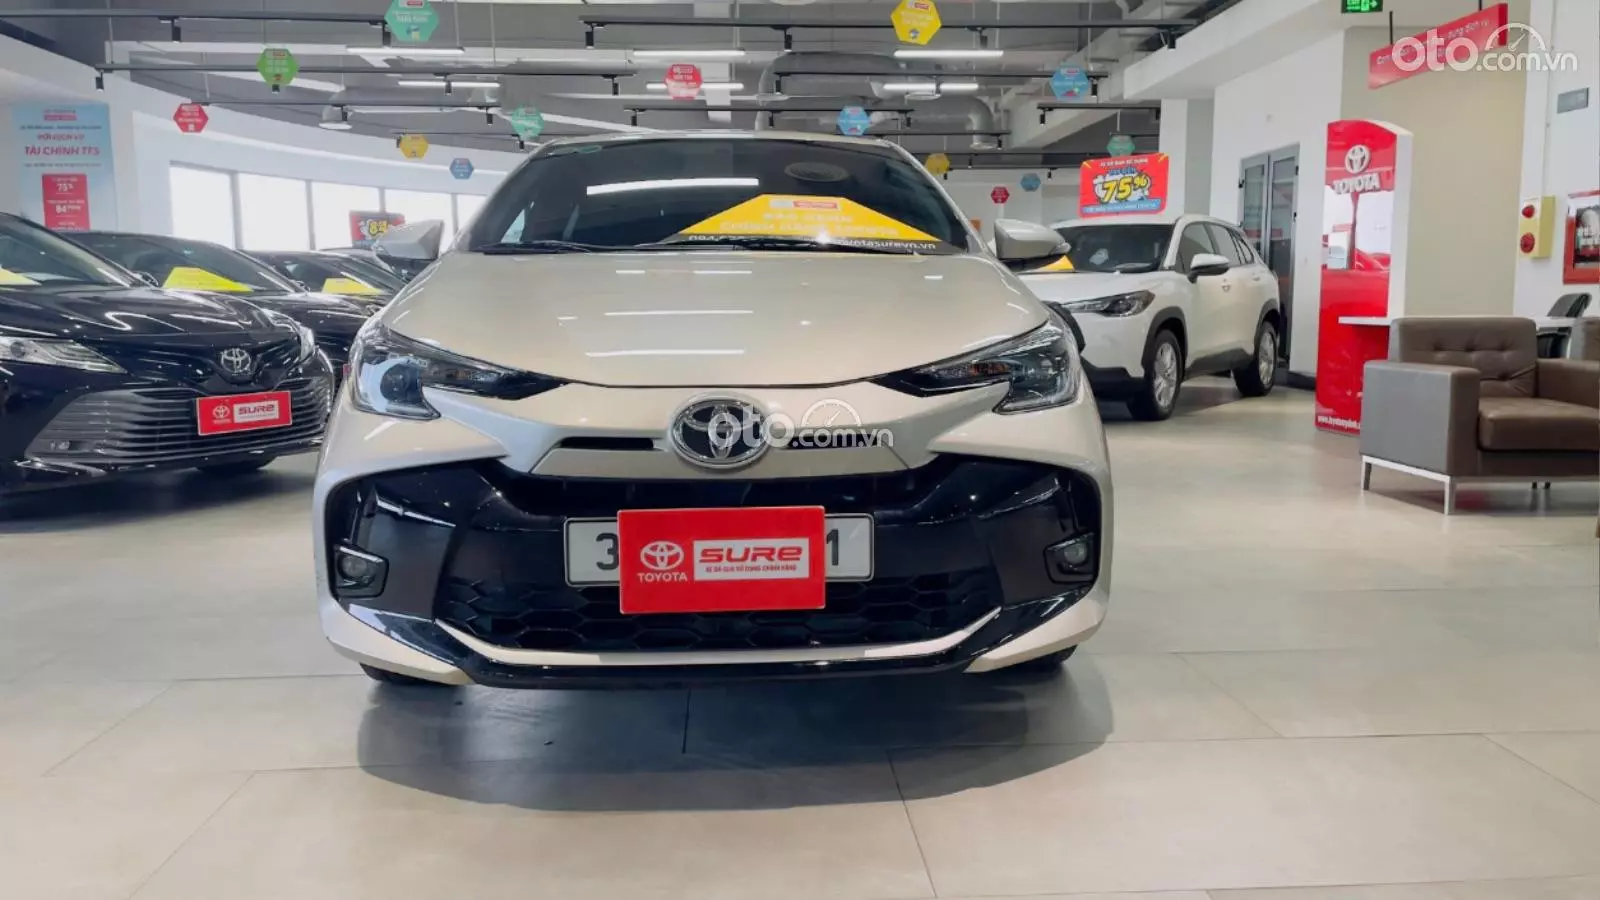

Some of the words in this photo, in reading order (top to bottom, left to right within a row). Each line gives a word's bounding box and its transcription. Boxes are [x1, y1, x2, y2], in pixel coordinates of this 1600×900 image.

[1102, 173, 1149, 203] 75%
[1332, 172, 1380, 194] TOYOTA
[636, 571, 688, 584] TOYOTA
